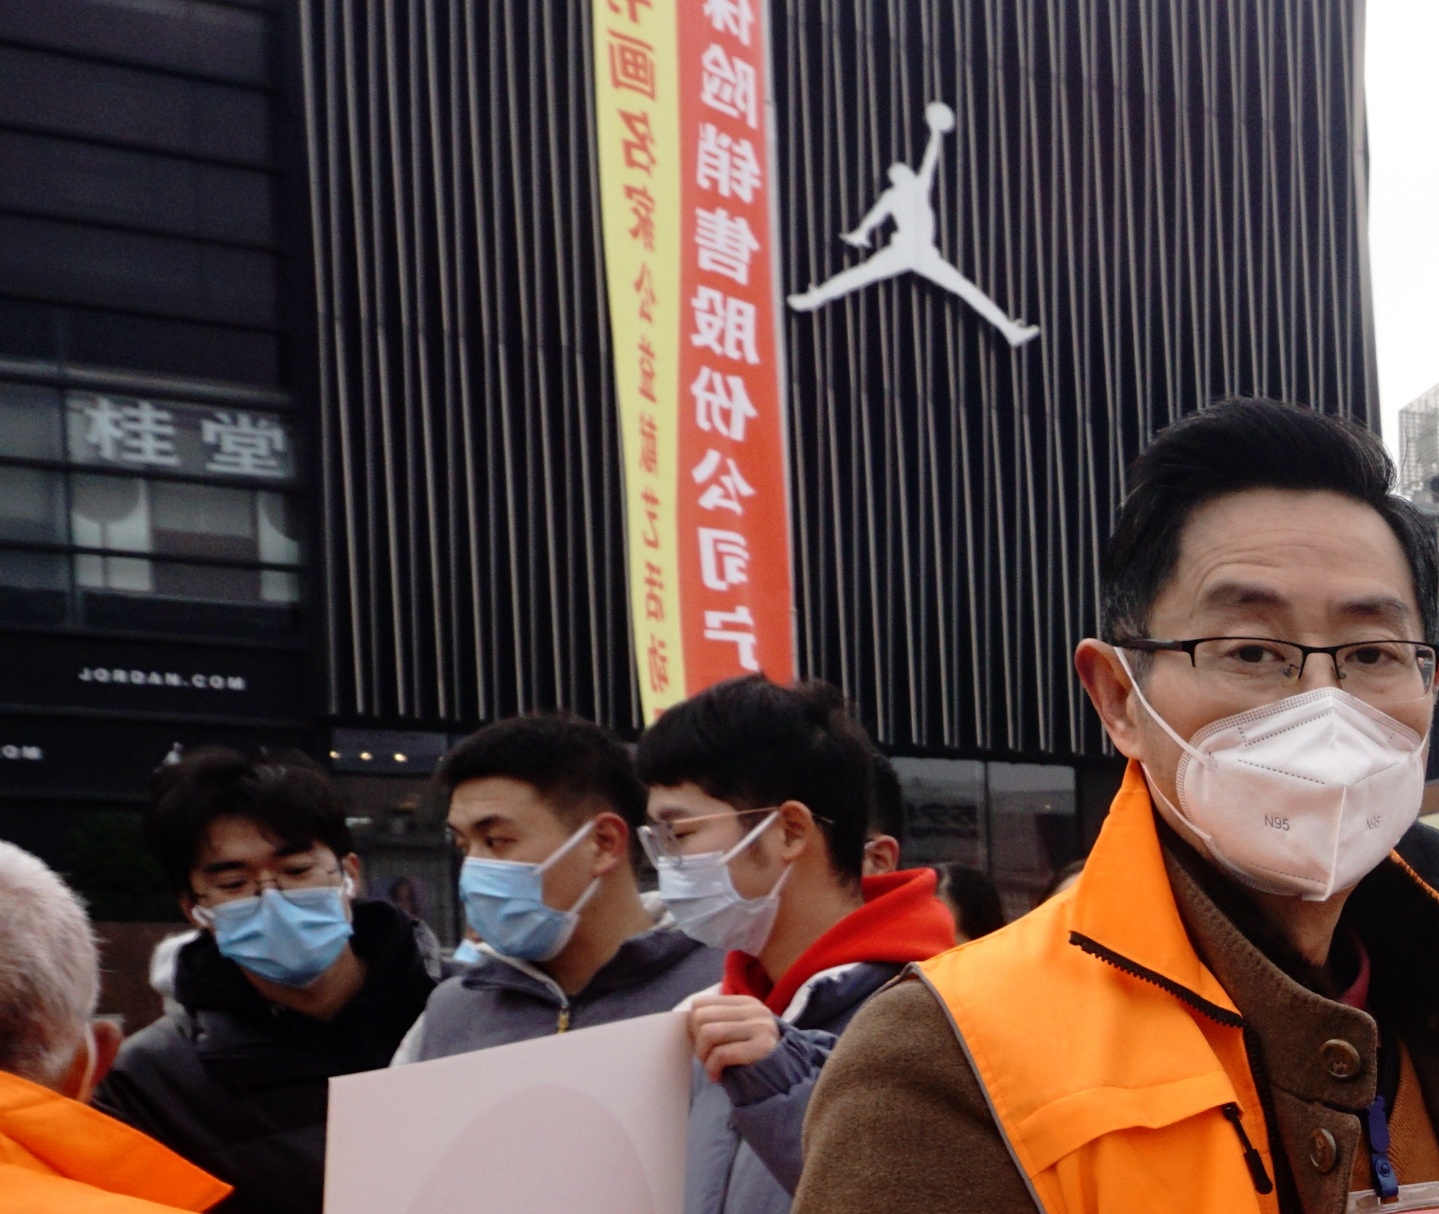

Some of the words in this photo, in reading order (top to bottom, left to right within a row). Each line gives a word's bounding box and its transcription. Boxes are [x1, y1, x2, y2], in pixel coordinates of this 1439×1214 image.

[83, 398, 292, 478] 桂堂
[78, 667, 246, 690] JORDAN.COM
[1264, 815, 1290, 831] N95
